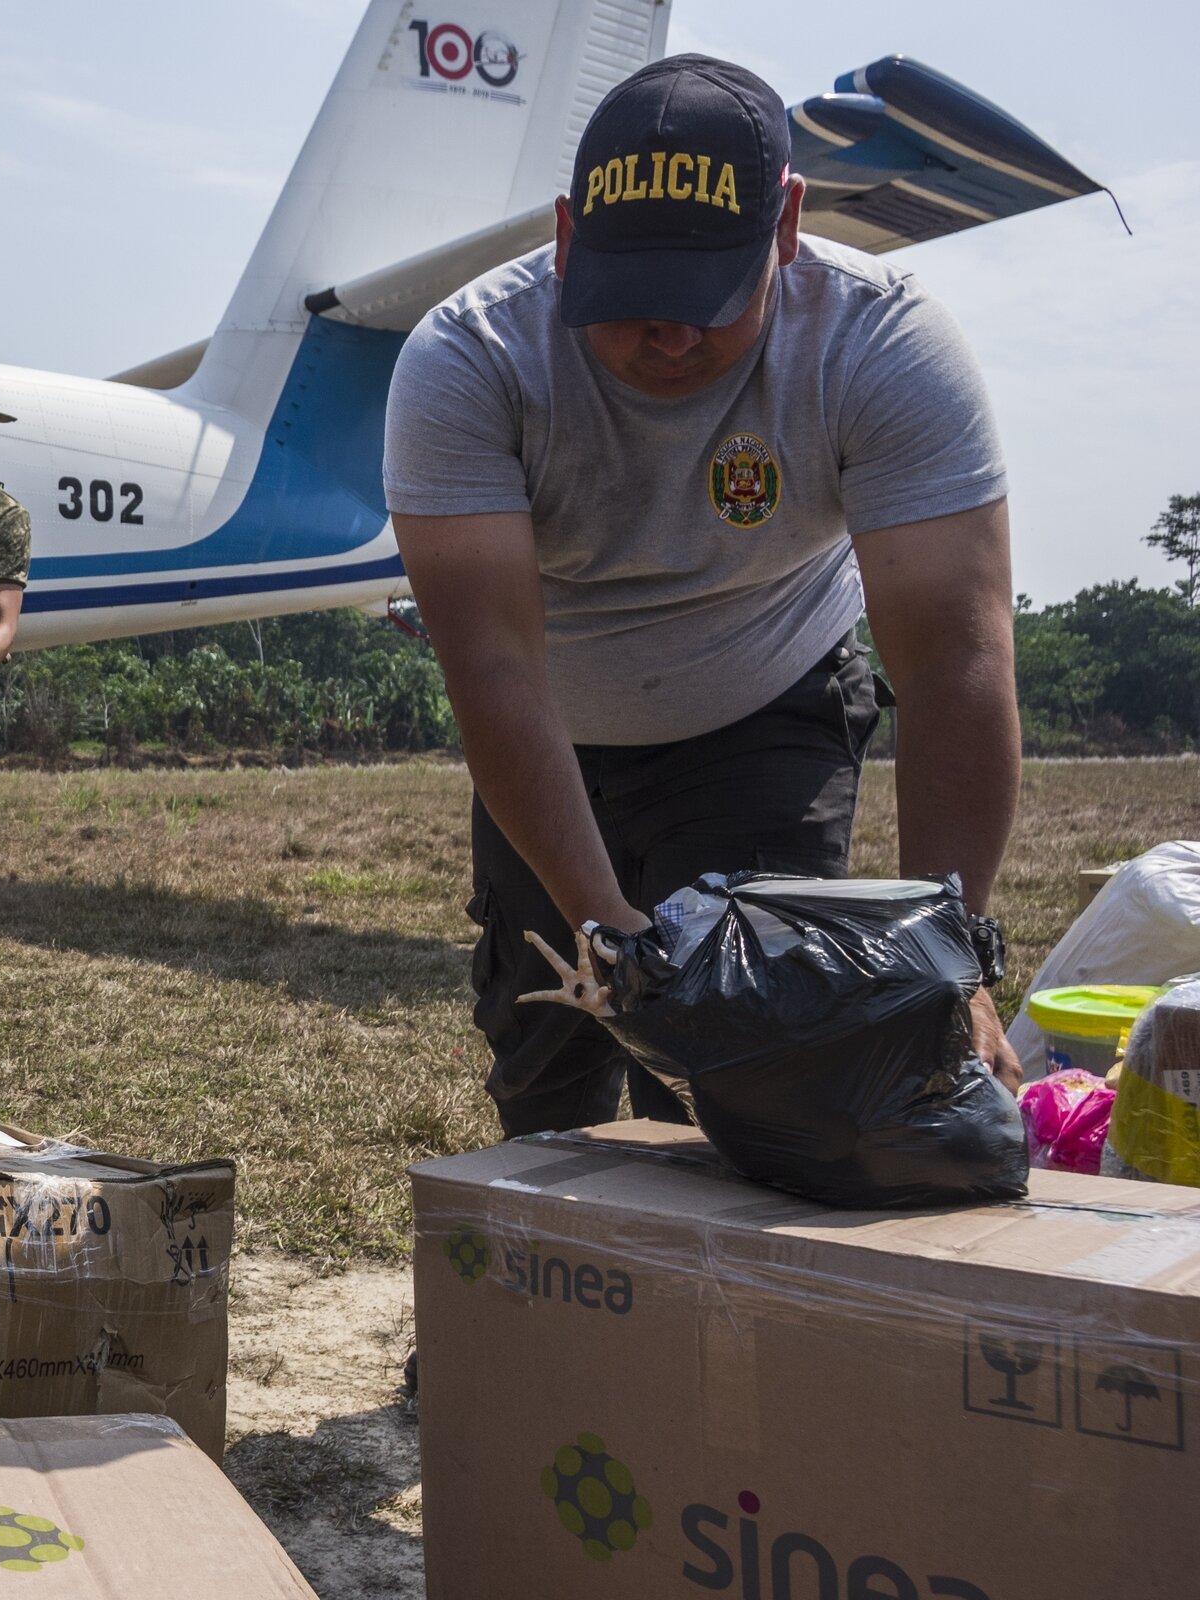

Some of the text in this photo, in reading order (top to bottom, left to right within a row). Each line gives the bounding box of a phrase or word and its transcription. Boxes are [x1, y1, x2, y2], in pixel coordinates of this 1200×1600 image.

[582, 151, 741, 217] POLICIA
[58, 476, 144, 525] 302
[503, 1241, 633, 1315] sinea
[681, 1490, 993, 1600] sine
